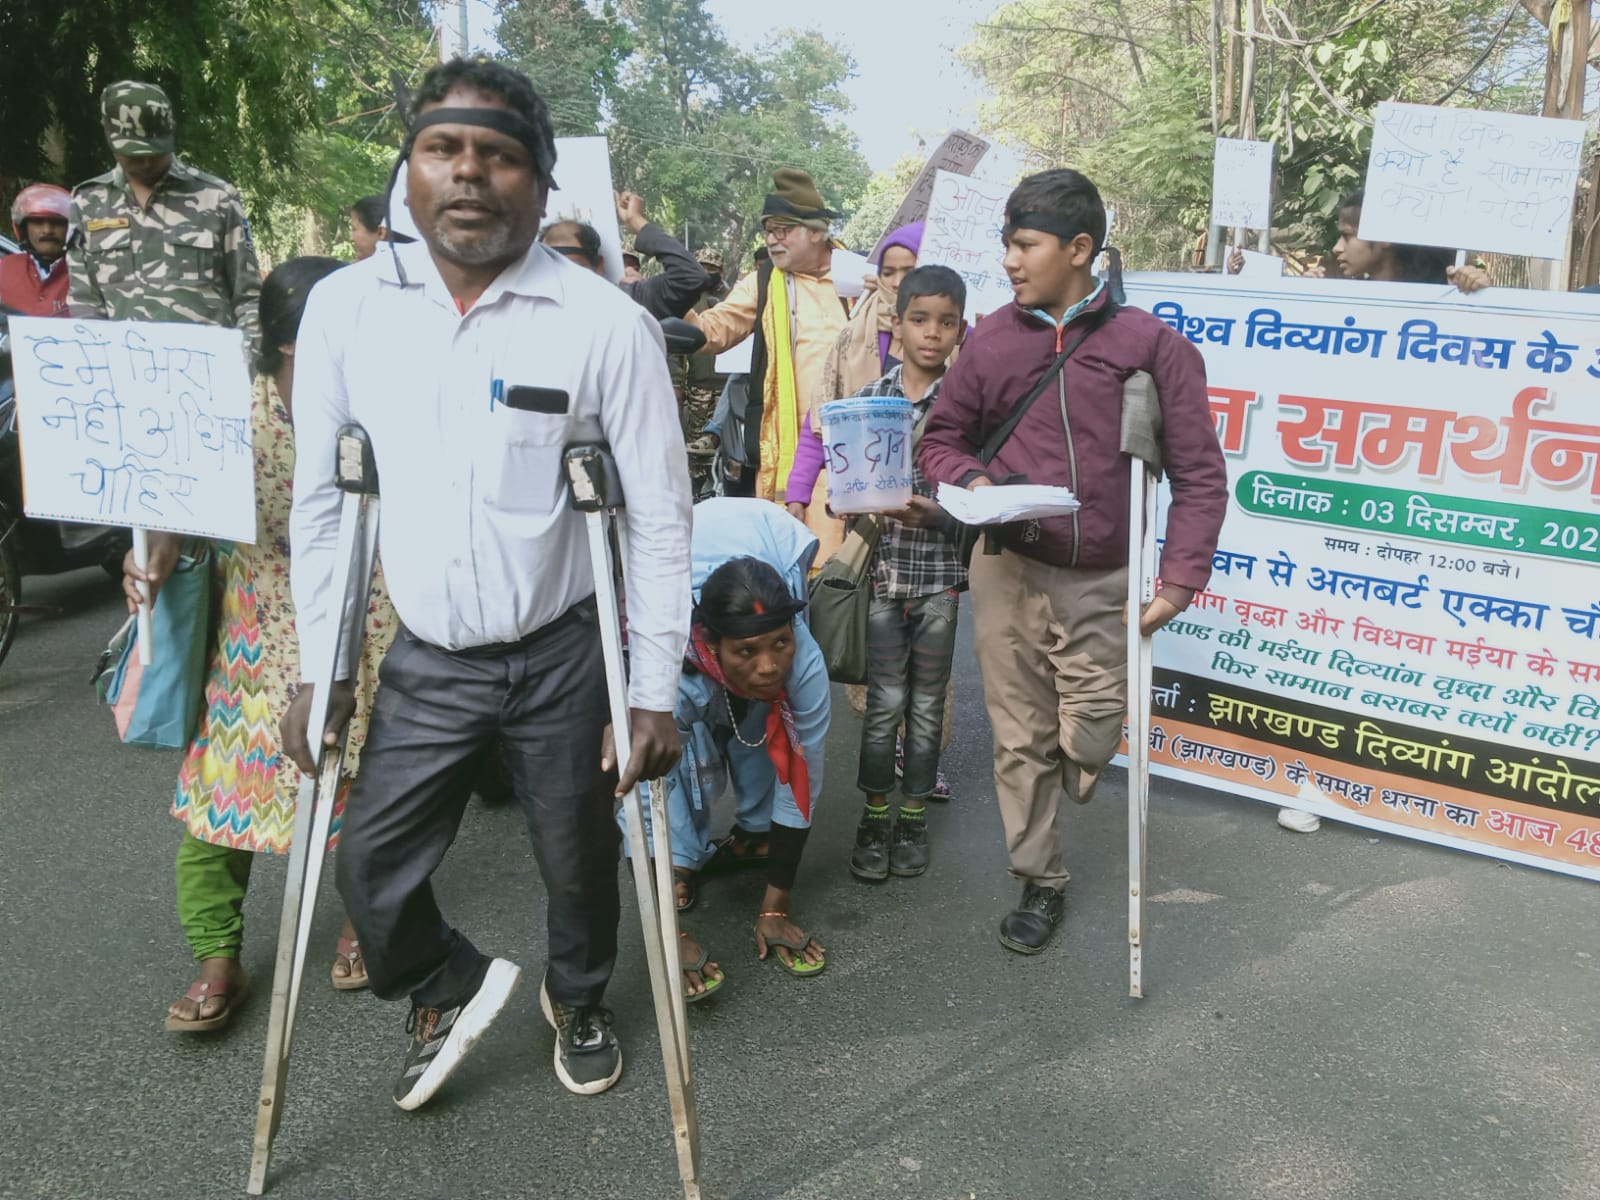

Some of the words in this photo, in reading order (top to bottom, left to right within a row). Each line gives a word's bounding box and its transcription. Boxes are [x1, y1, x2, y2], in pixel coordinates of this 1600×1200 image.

[1245, 308, 1387, 358] दिव्यांग
[1396, 319, 1516, 370] दिवस
[1526, 330, 1579, 374] के
[1206, 387, 1257, 452] न
[1276, 386, 1600, 496] समर्थन
[1252, 474, 1334, 513] दिनांक
[1341, 499, 1349, 515] :
[1360, 500, 1394, 524] 03
[1406, 495, 1525, 548] दिसम्बर,
[1540, 522, 1600, 552] 202
[1212, 550, 1258, 580] वन
[1266, 550, 1297, 588] से
[1306, 566, 1430, 609] अलबर्ट
[1439, 589, 1552, 632] एक्का
[1324, 537, 1360, 554] समय
[1377, 542, 1422, 565] दोपहर
[1428, 555, 1476, 573] 12:00
[1160, 619, 1215, 641] खण्ड
[1218, 629, 1253, 650] की
[1258, 639, 1323, 666] मईया
[1328, 649, 1427, 687] दिव्यांग
[1503, 685, 1560, 712] और
[1233, 599, 1288, 628] वृद्धा
[1296, 608, 1345, 639] और
[1352, 616, 1437, 656] विधवा
[1446, 636, 1518, 670] मईया
[1526, 648, 1559, 677] के
[1211, 651, 1259, 679] फिर
[1265, 668, 1354, 700] सम्मान
[1361, 690, 1450, 721] बराबर
[1458, 711, 1519, 734] क्यों
[1208, 693, 1346, 749] झारखण्ड
[1354, 721, 1475, 779] दिव्यांग
[1172, 735, 1276, 781] (झारखण्ड)
[1285, 761, 1309, 785] के
[1315, 772, 1374, 807] समक्ष
[1382, 789, 1440, 818] धरना
[1445, 803, 1481, 828] का
[1486, 810, 1560, 845] आज
